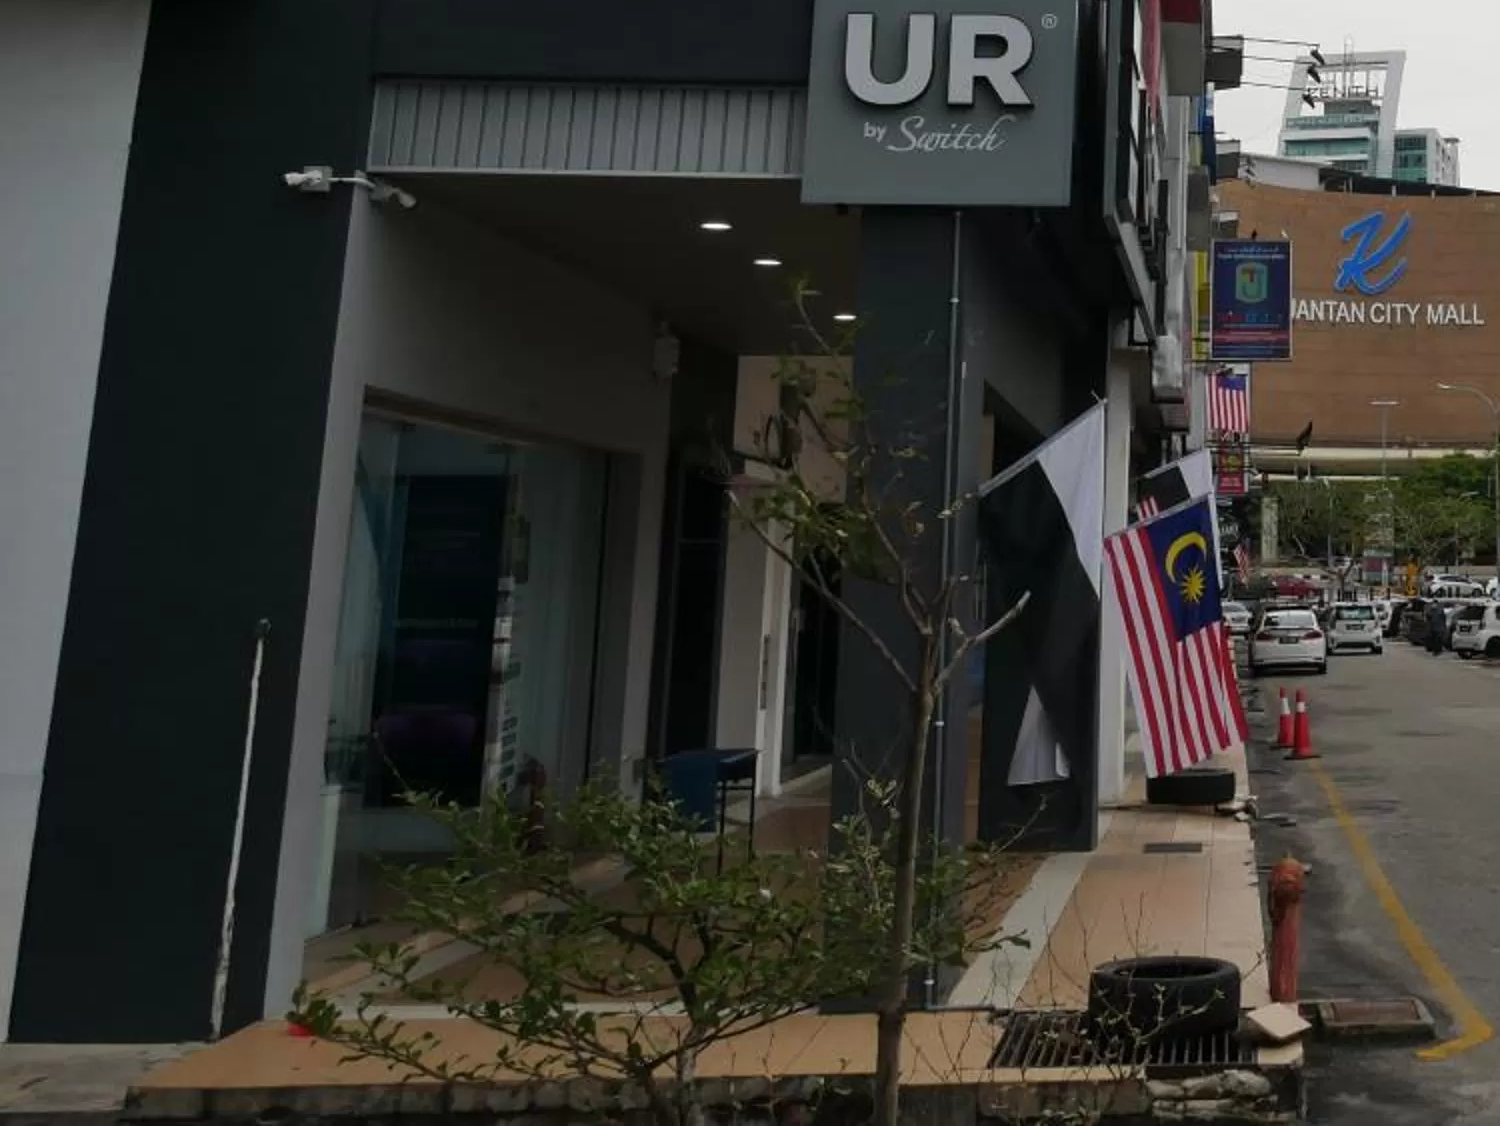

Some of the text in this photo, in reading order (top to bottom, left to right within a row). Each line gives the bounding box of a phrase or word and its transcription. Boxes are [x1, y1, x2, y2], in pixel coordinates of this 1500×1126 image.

[844, 13, 1034, 106] UR
[863, 114, 1016, 152] by Switch
[1370, 302, 1421, 325] CITY
[1427, 304, 1485, 326] MALL
